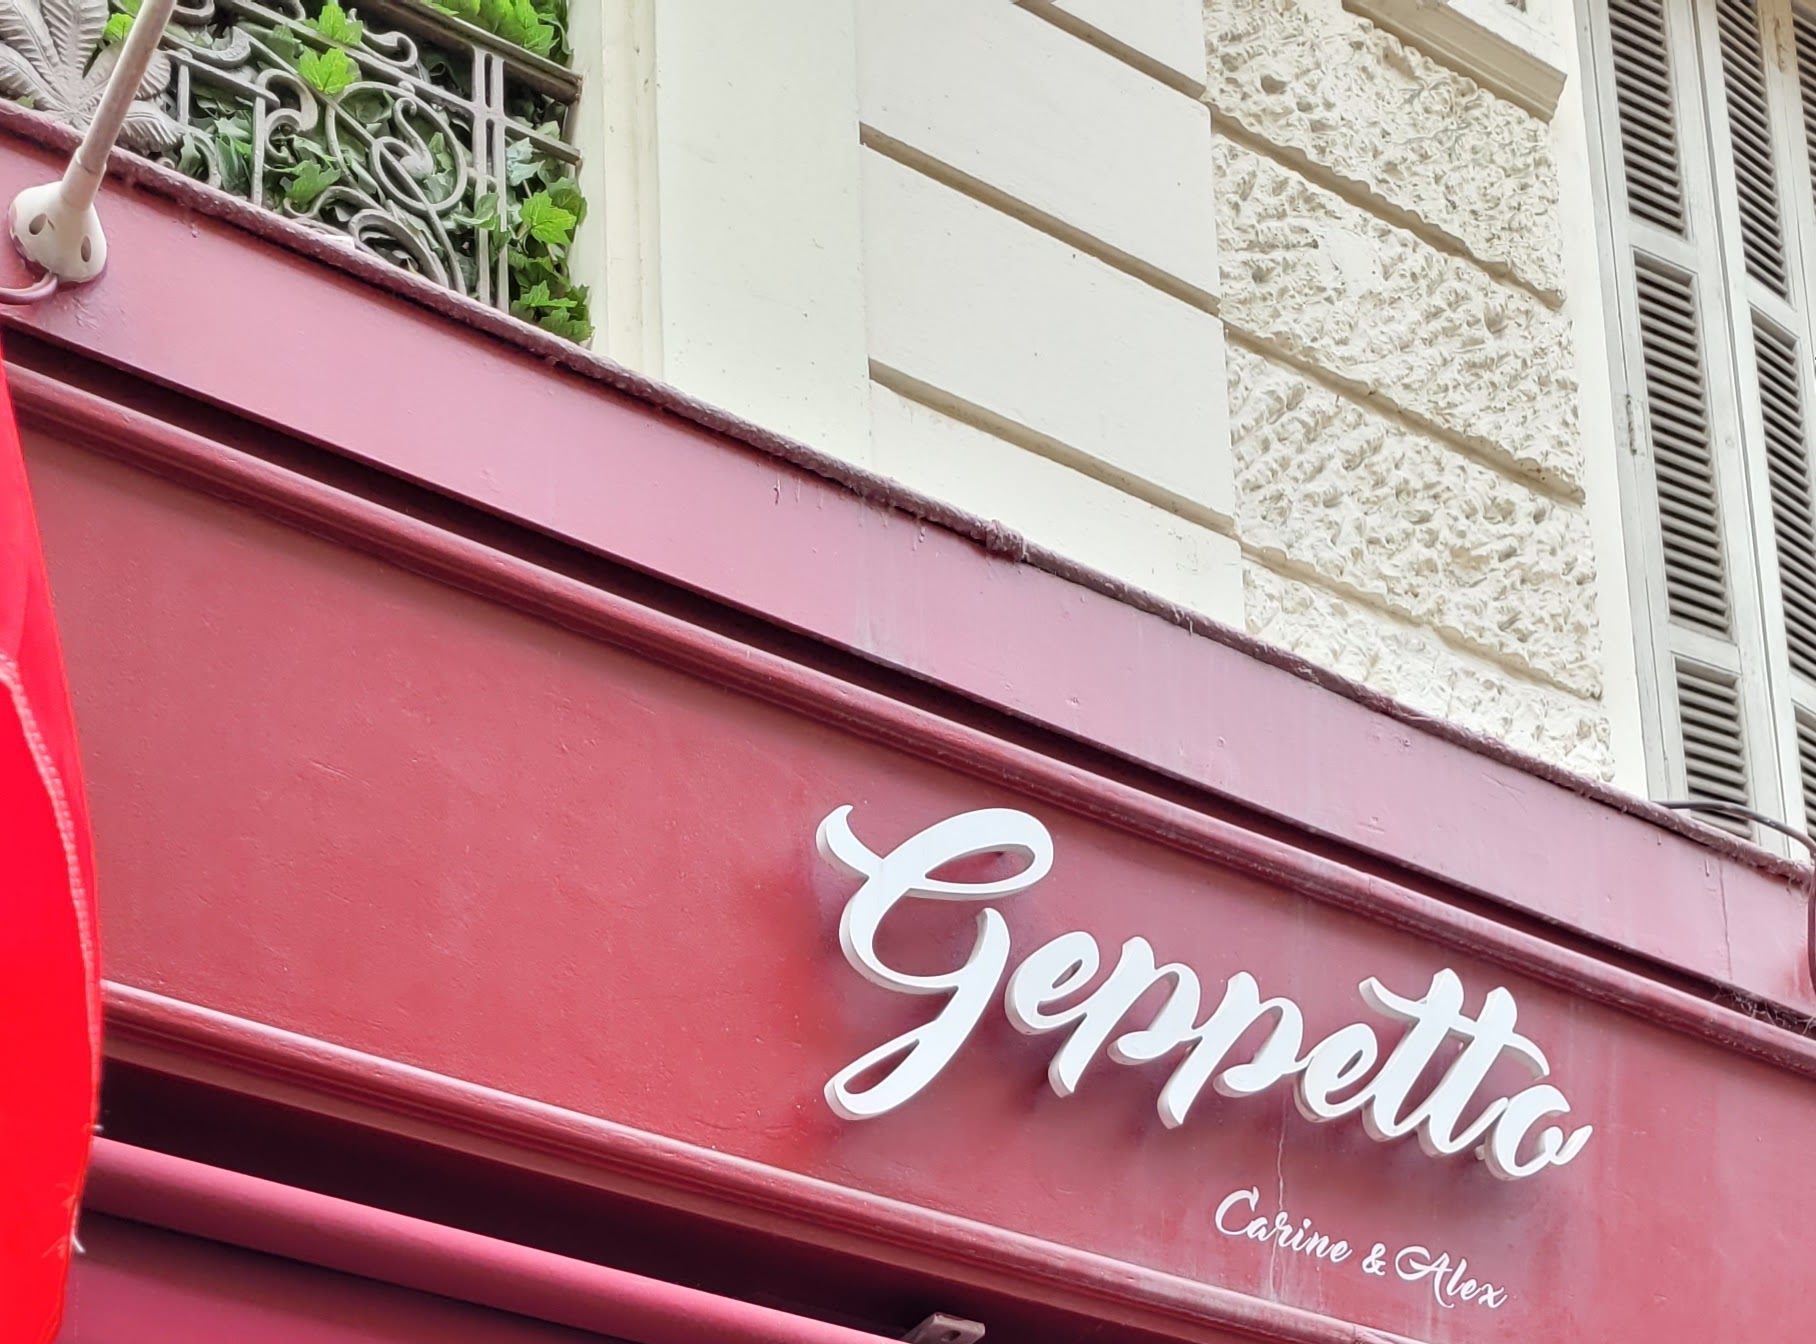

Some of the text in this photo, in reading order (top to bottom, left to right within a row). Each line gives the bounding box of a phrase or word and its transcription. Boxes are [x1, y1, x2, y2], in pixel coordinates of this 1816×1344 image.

[816, 804, 1595, 1182] Geppetto
[1214, 1186, 1509, 1309] Carine & Alex
